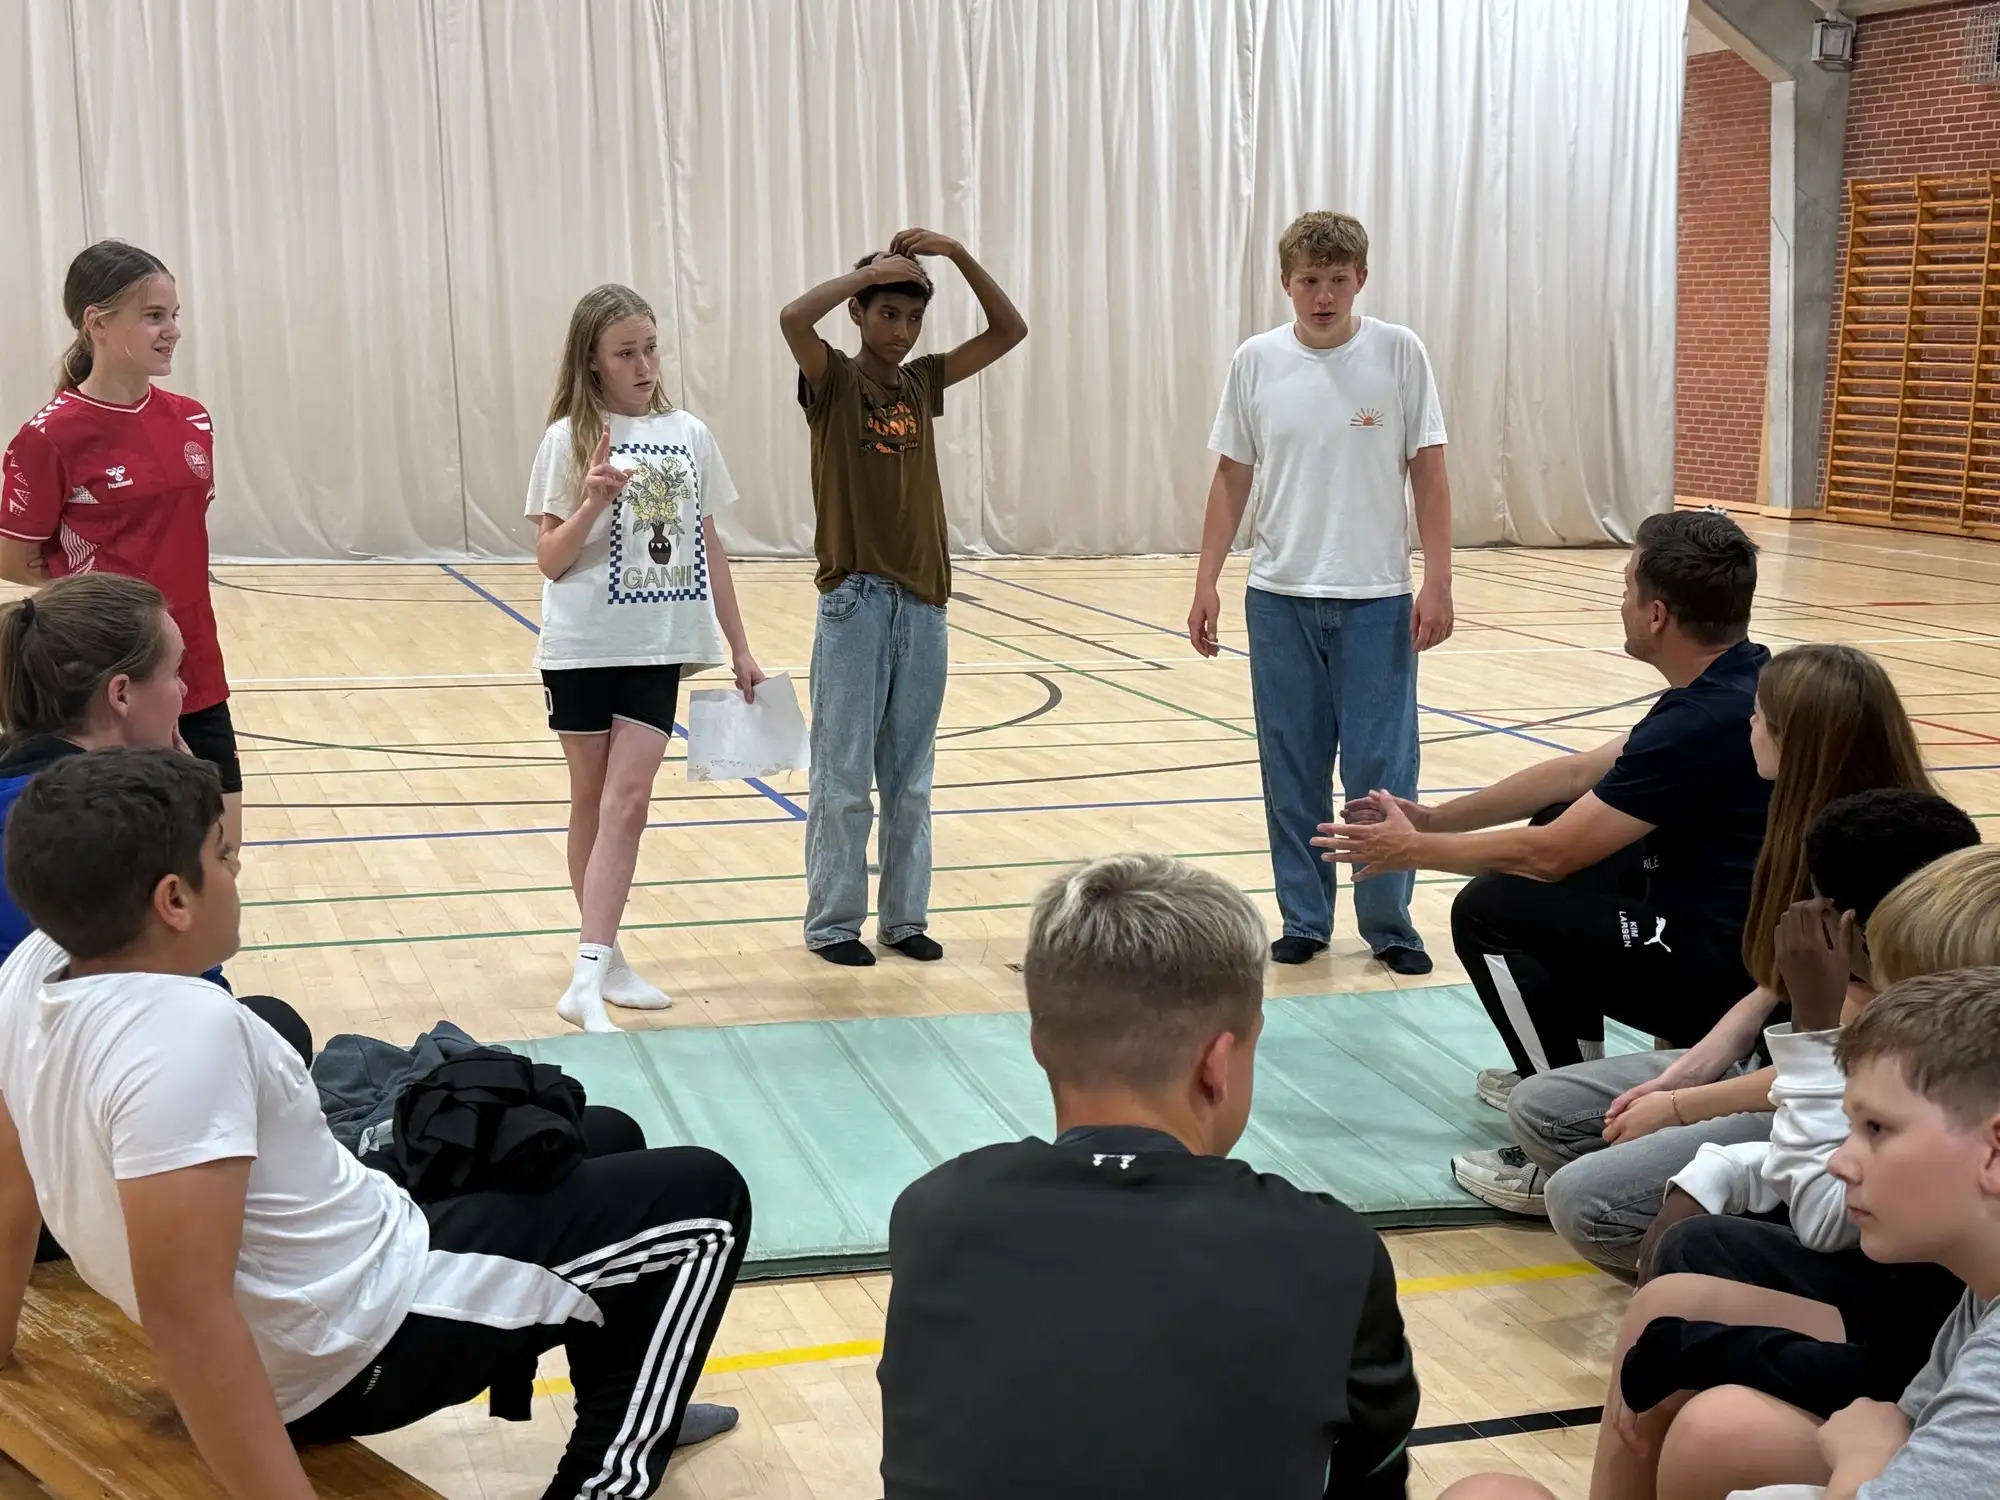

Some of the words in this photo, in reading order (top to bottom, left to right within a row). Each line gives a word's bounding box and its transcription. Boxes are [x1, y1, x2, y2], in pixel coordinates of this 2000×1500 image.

[623, 565, 692, 589] GANNI
[1619, 911, 1632, 947] LARSEN
[1629, 921, 1639, 938] KIM
